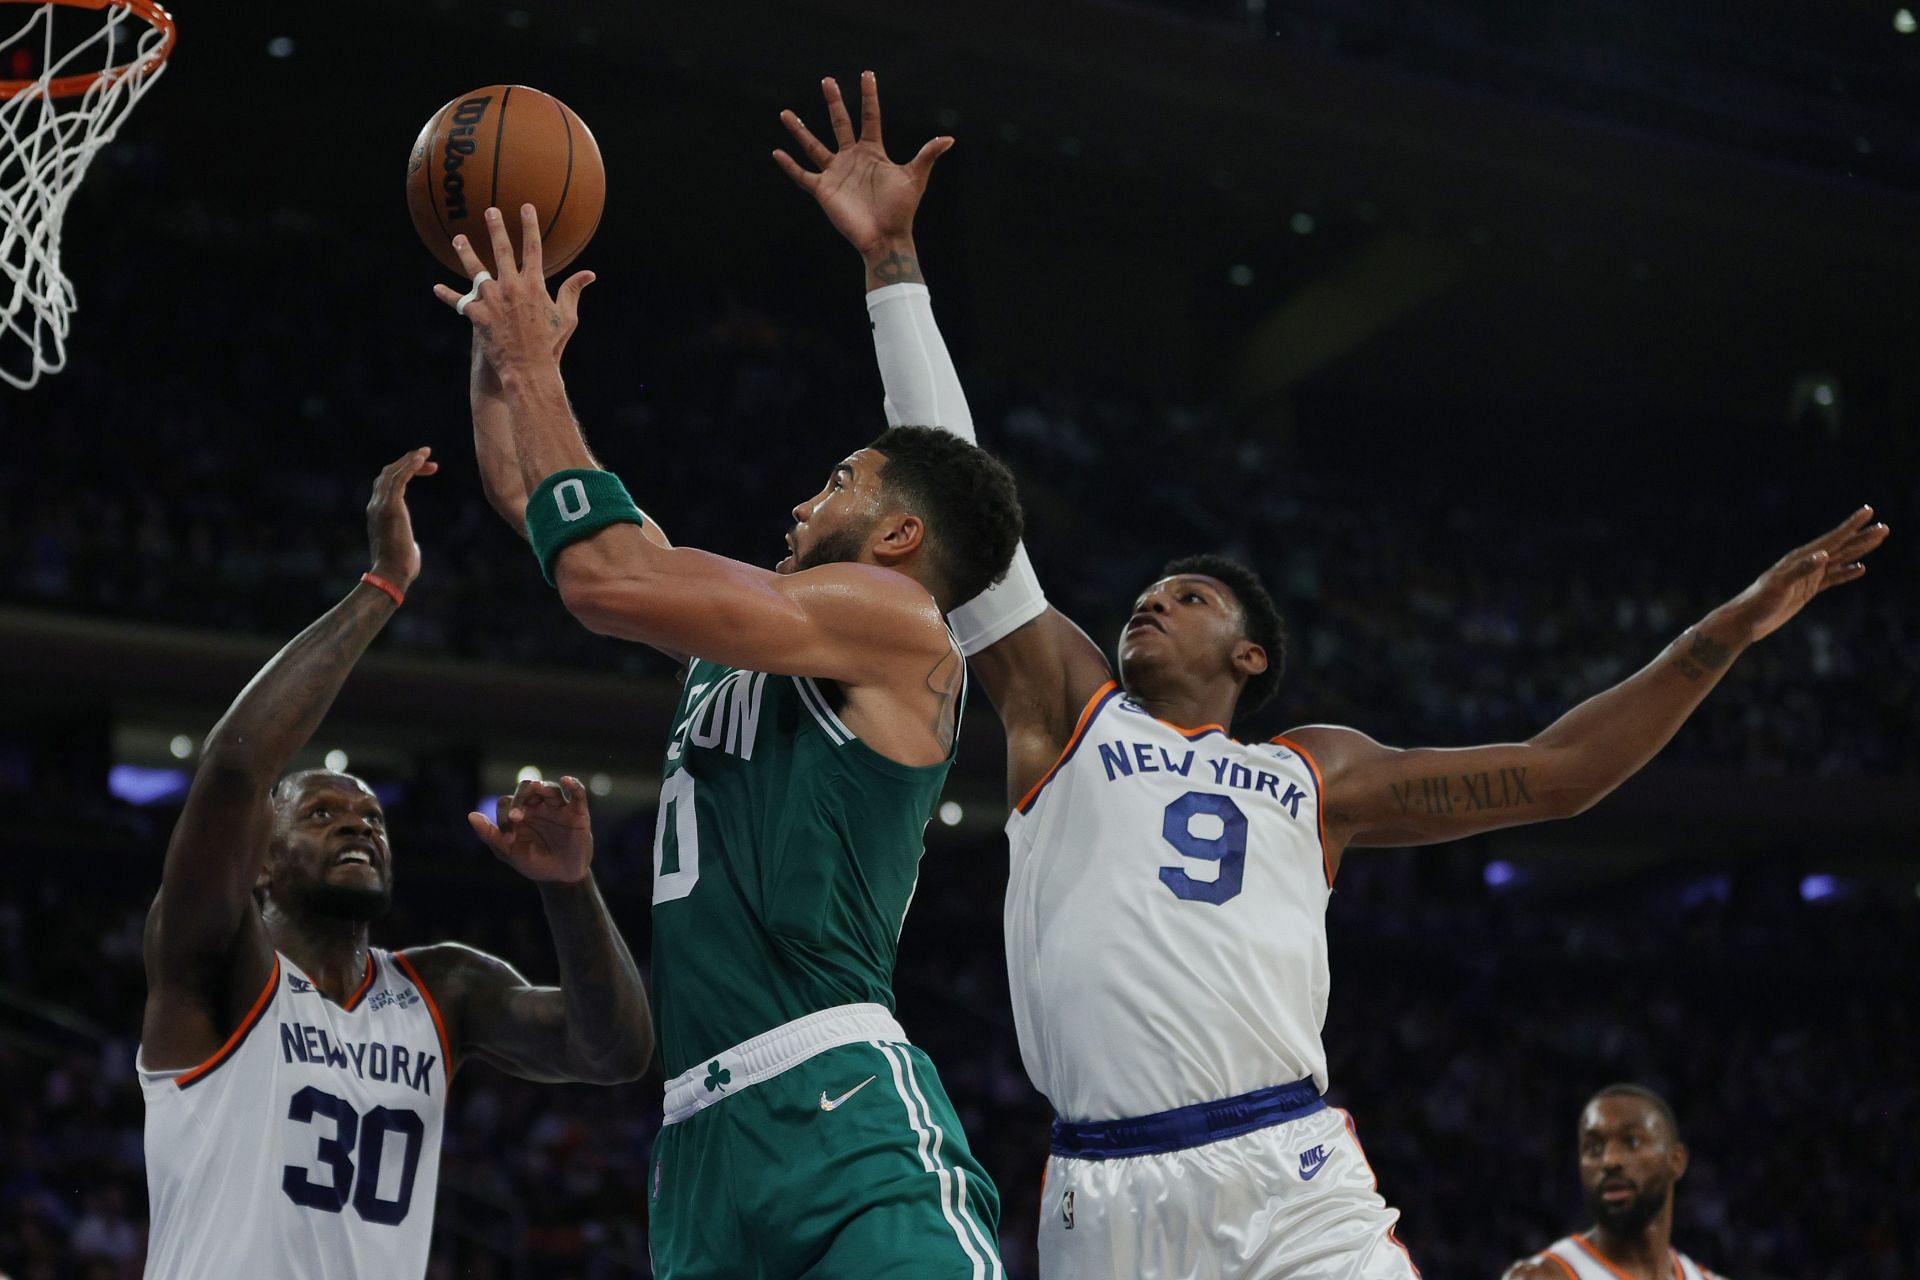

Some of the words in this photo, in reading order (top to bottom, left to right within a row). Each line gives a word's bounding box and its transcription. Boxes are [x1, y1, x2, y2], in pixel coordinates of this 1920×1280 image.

[443, 95, 493, 219] Wilson
[553, 478, 591, 522] 0
[1098, 740, 1195, 782] NEW
[1207, 757, 1308, 821] YORK
[1158, 791, 1249, 906] 9
[280, 1023, 348, 1069] NEW
[346, 1042, 437, 1096] YORK
[281, 1085, 424, 1227] 30
[1299, 1144, 1325, 1169] NIKE
